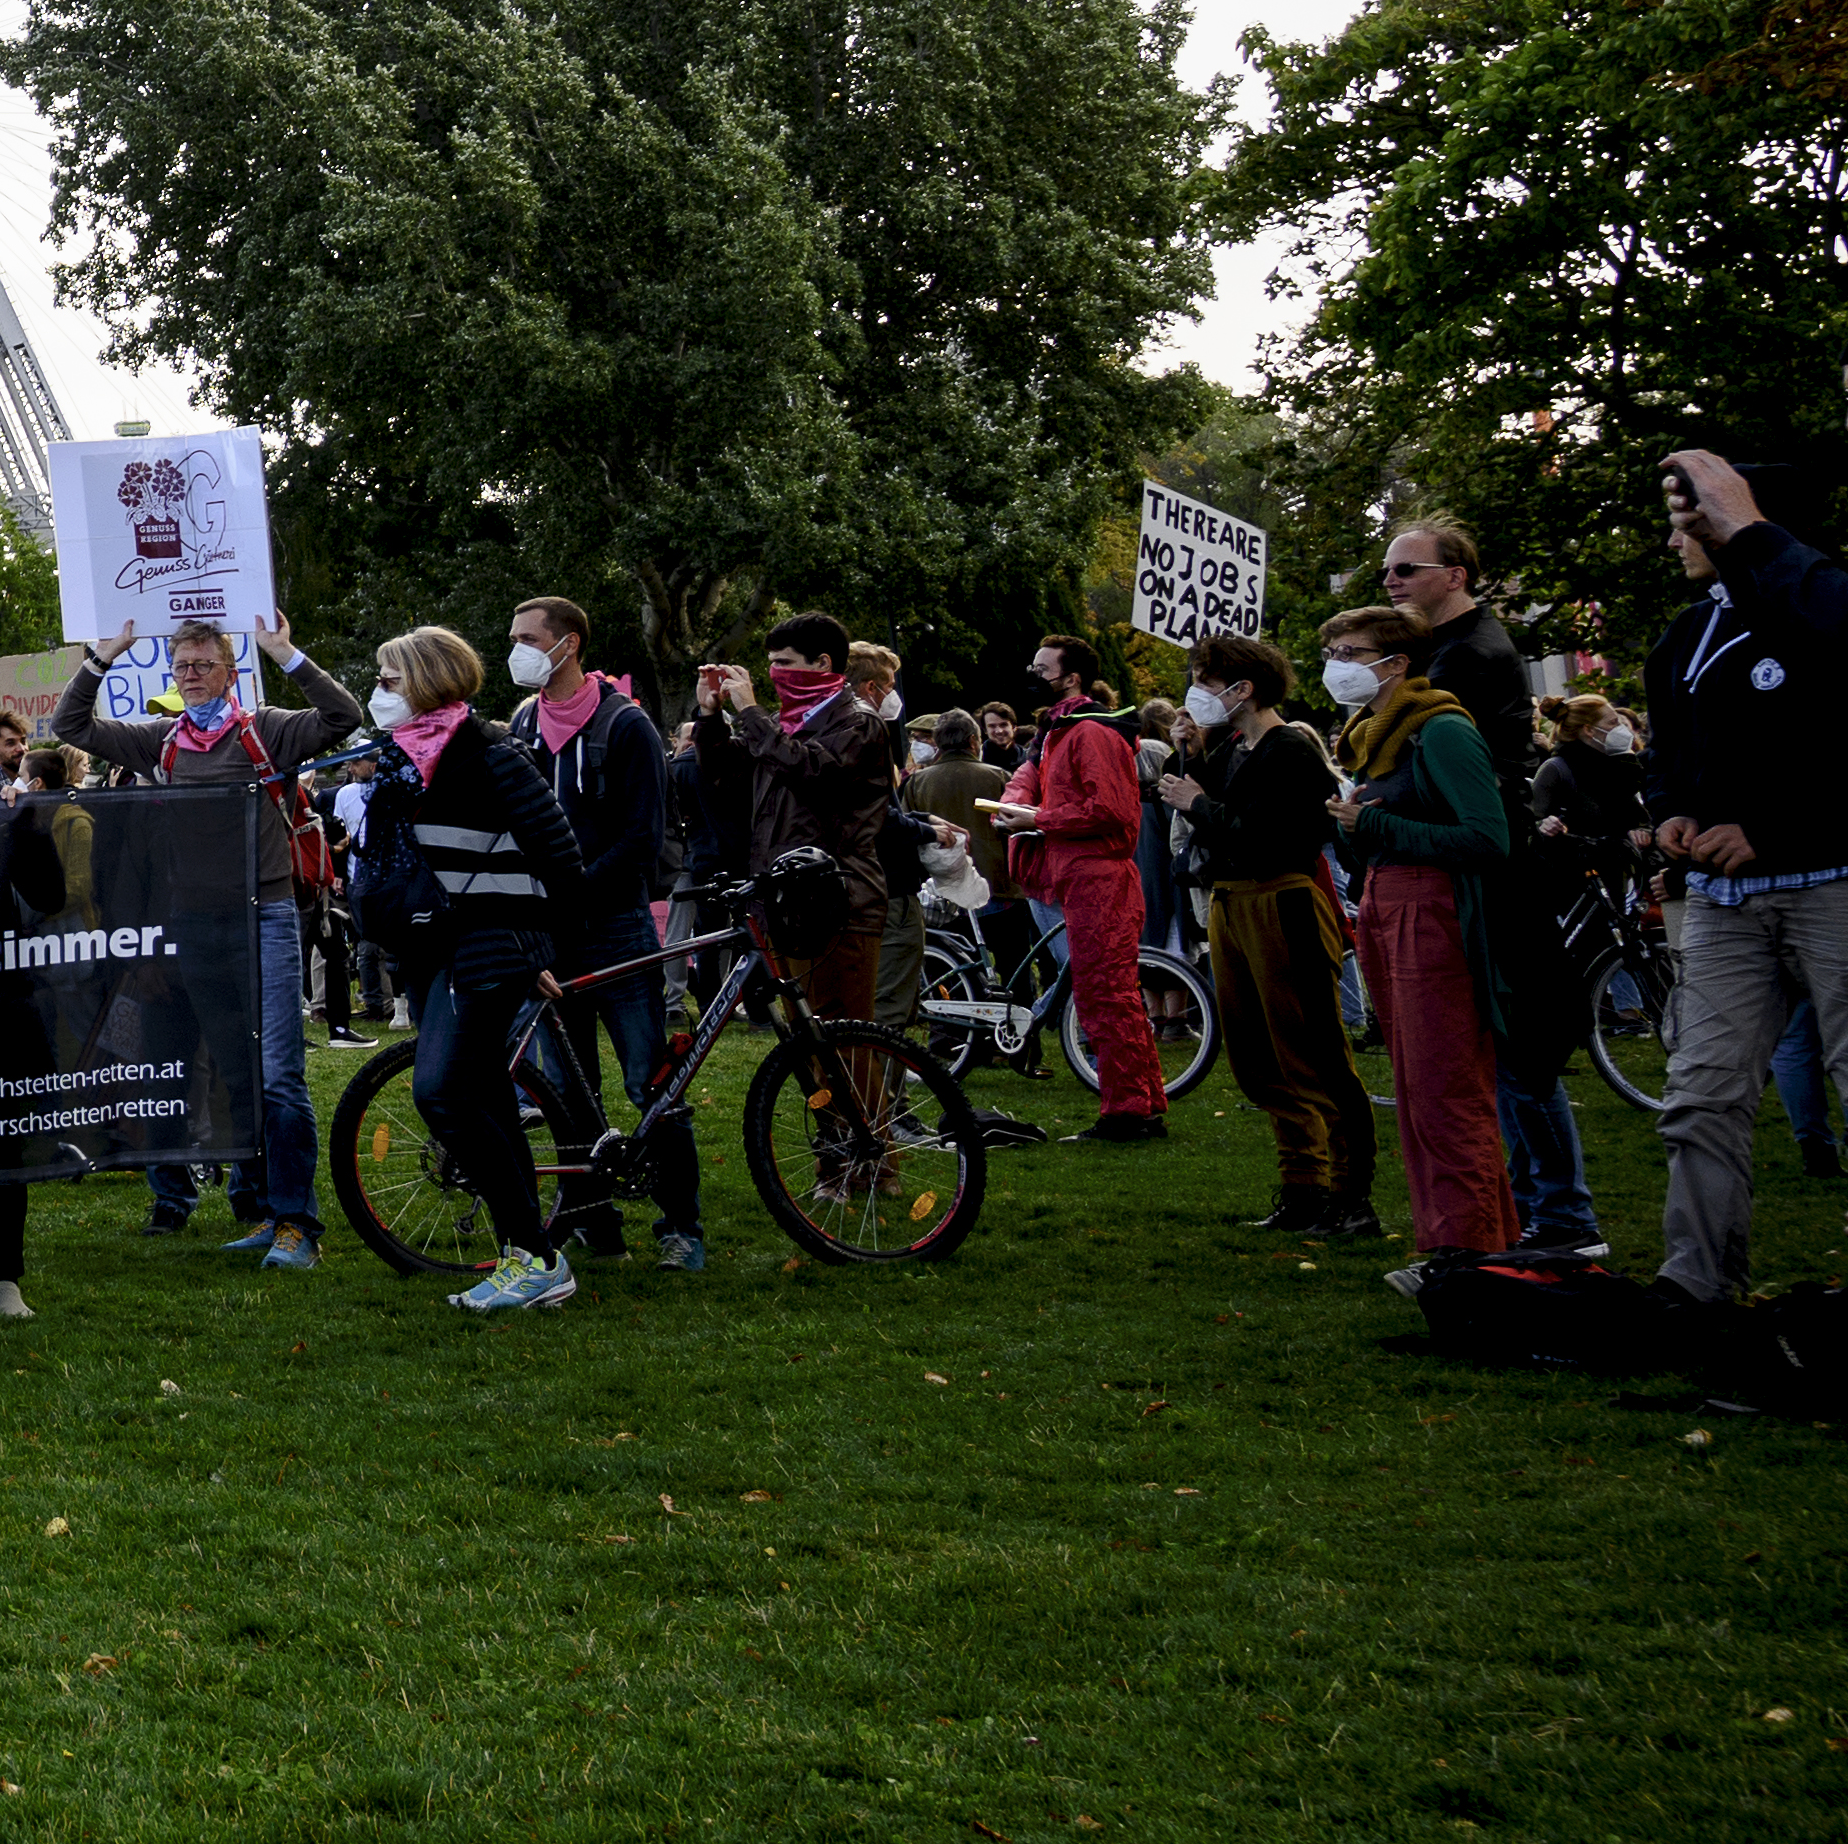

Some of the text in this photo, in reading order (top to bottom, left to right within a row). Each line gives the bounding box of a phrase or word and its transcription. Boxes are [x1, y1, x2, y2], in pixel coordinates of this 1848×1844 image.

[139, 524, 176, 534] GENUSS
[140, 534, 177, 543] REGION
[115, 557, 191, 594] Genuss
[1140, 533, 1259, 606] NO JOBS
[169, 595, 226, 612] GANGER
[1139, 568, 1259, 637] ON A DEAD
[15, 651, 71, 689] CO2
